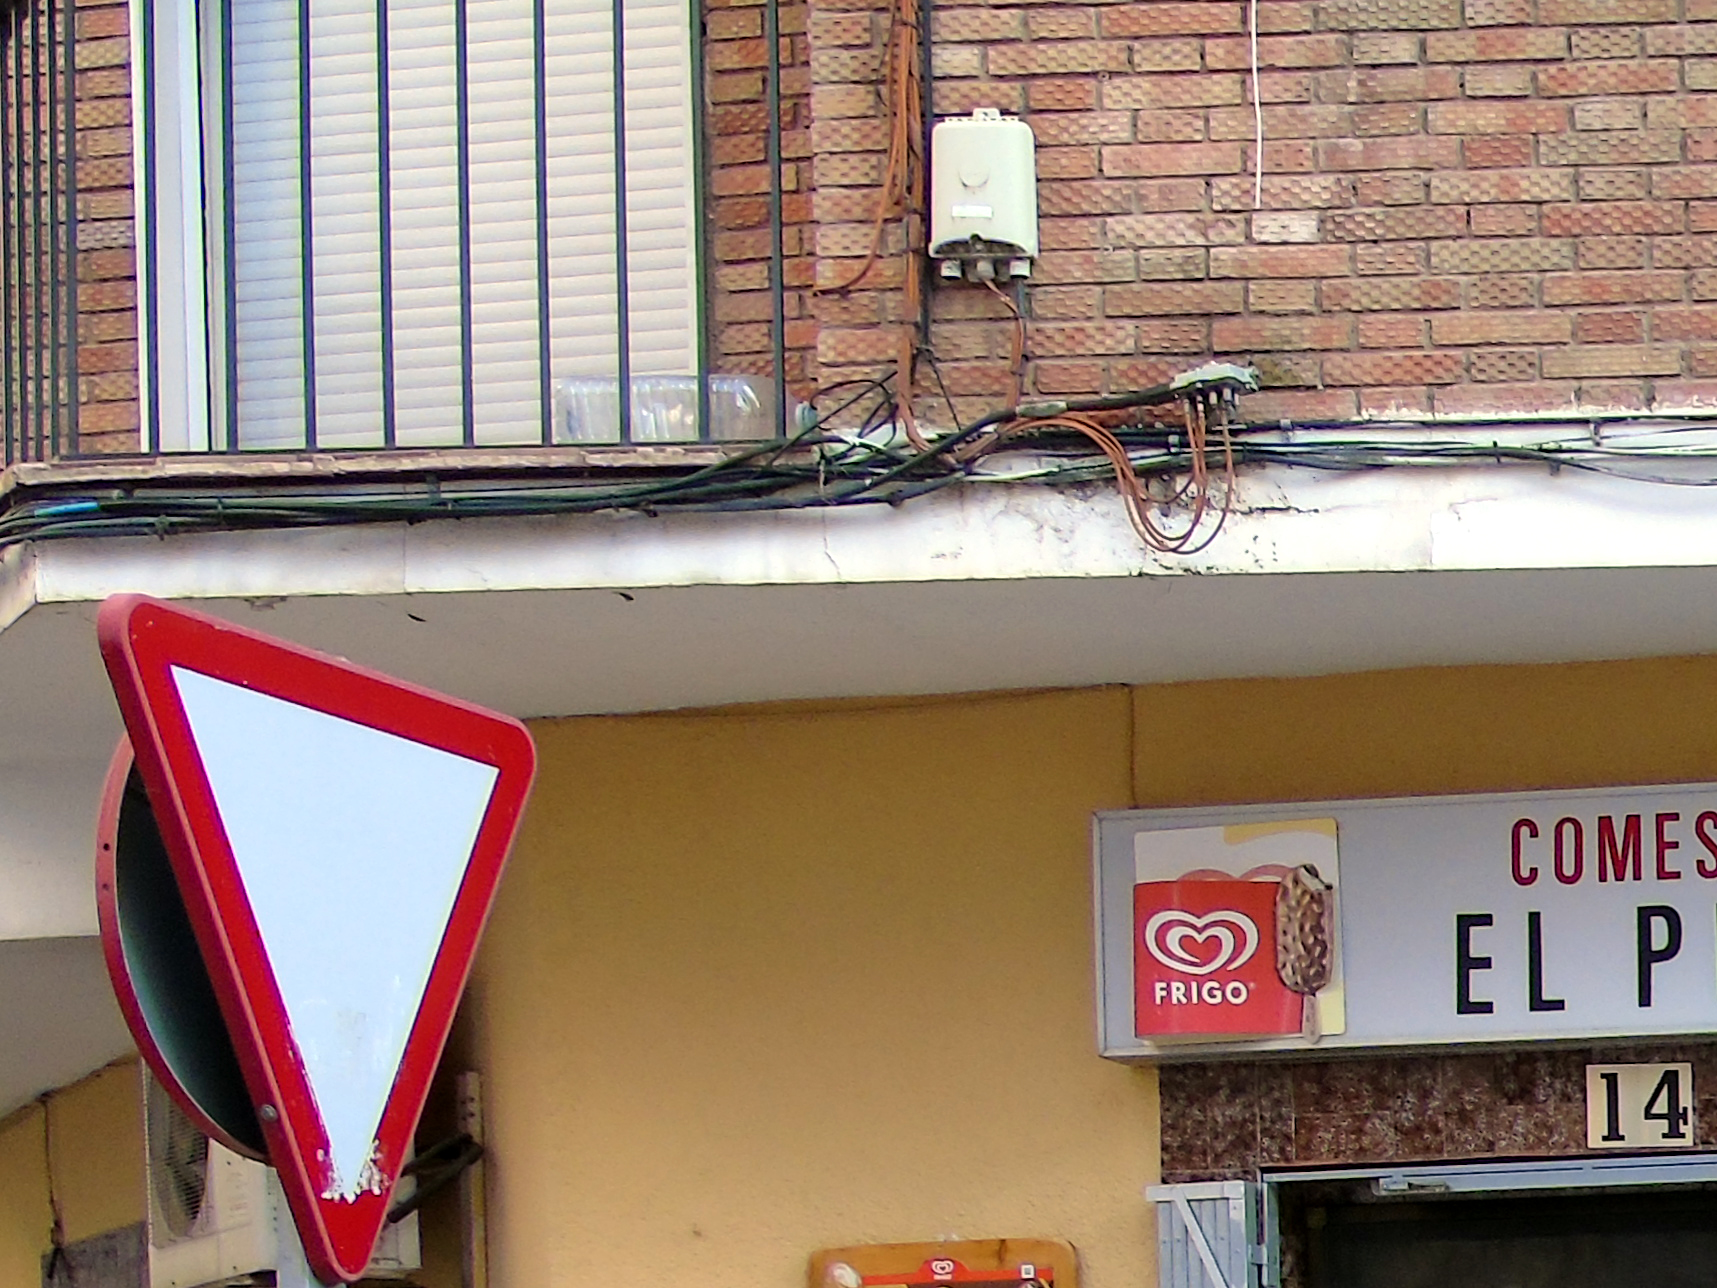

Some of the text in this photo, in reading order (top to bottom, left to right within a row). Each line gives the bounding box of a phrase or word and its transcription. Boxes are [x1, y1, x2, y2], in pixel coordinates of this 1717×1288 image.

[1154, 980, 1248, 1006] FRIGO
[1455, 910, 1567, 1017] EL
[1598, 1069, 1690, 1143] 14
